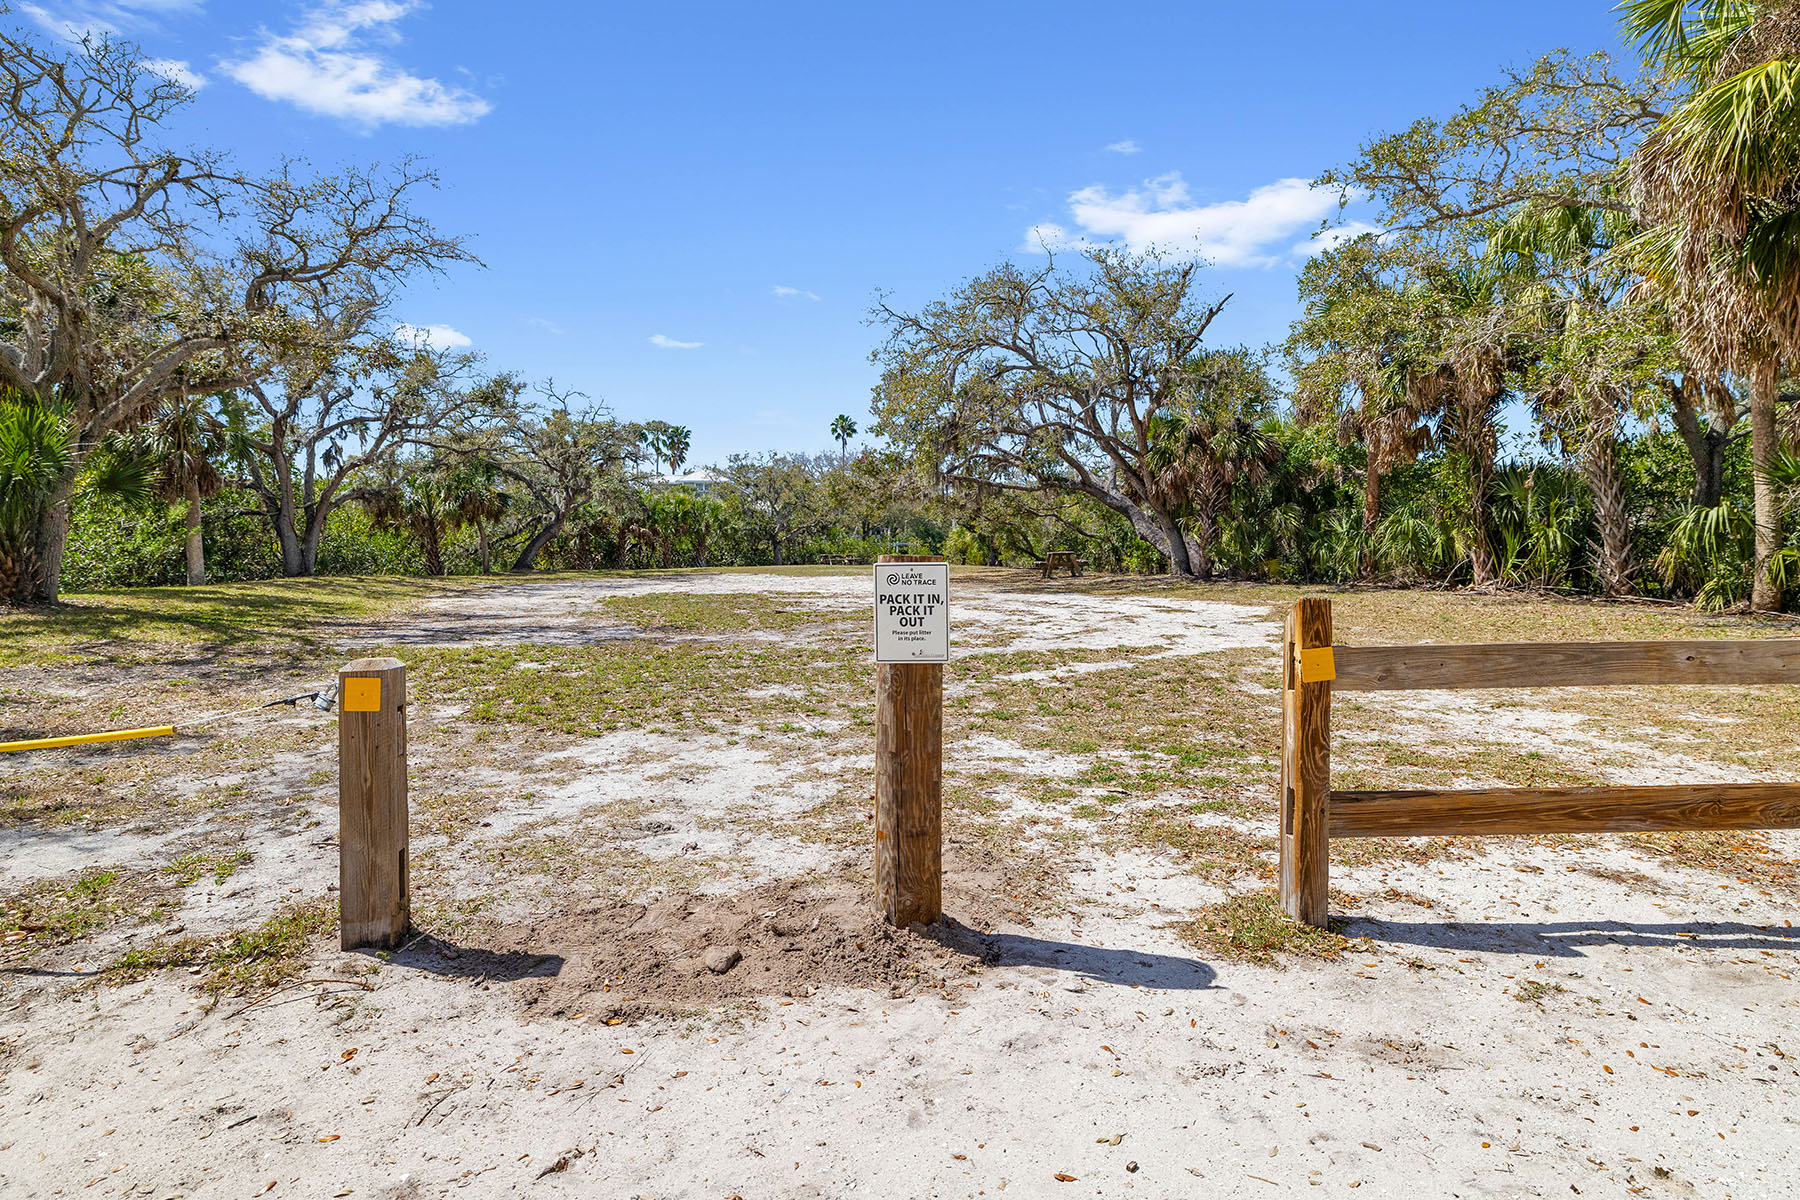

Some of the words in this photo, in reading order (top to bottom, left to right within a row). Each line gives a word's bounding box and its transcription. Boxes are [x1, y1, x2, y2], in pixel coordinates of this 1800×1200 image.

[880, 594, 910, 604] PACK
[914, 594, 924, 604] IT
[928, 594, 944, 606] IN,
[890, 606, 920, 616] PACK
[924, 606, 934, 616] IT
[900, 616, 924, 627] OUT
